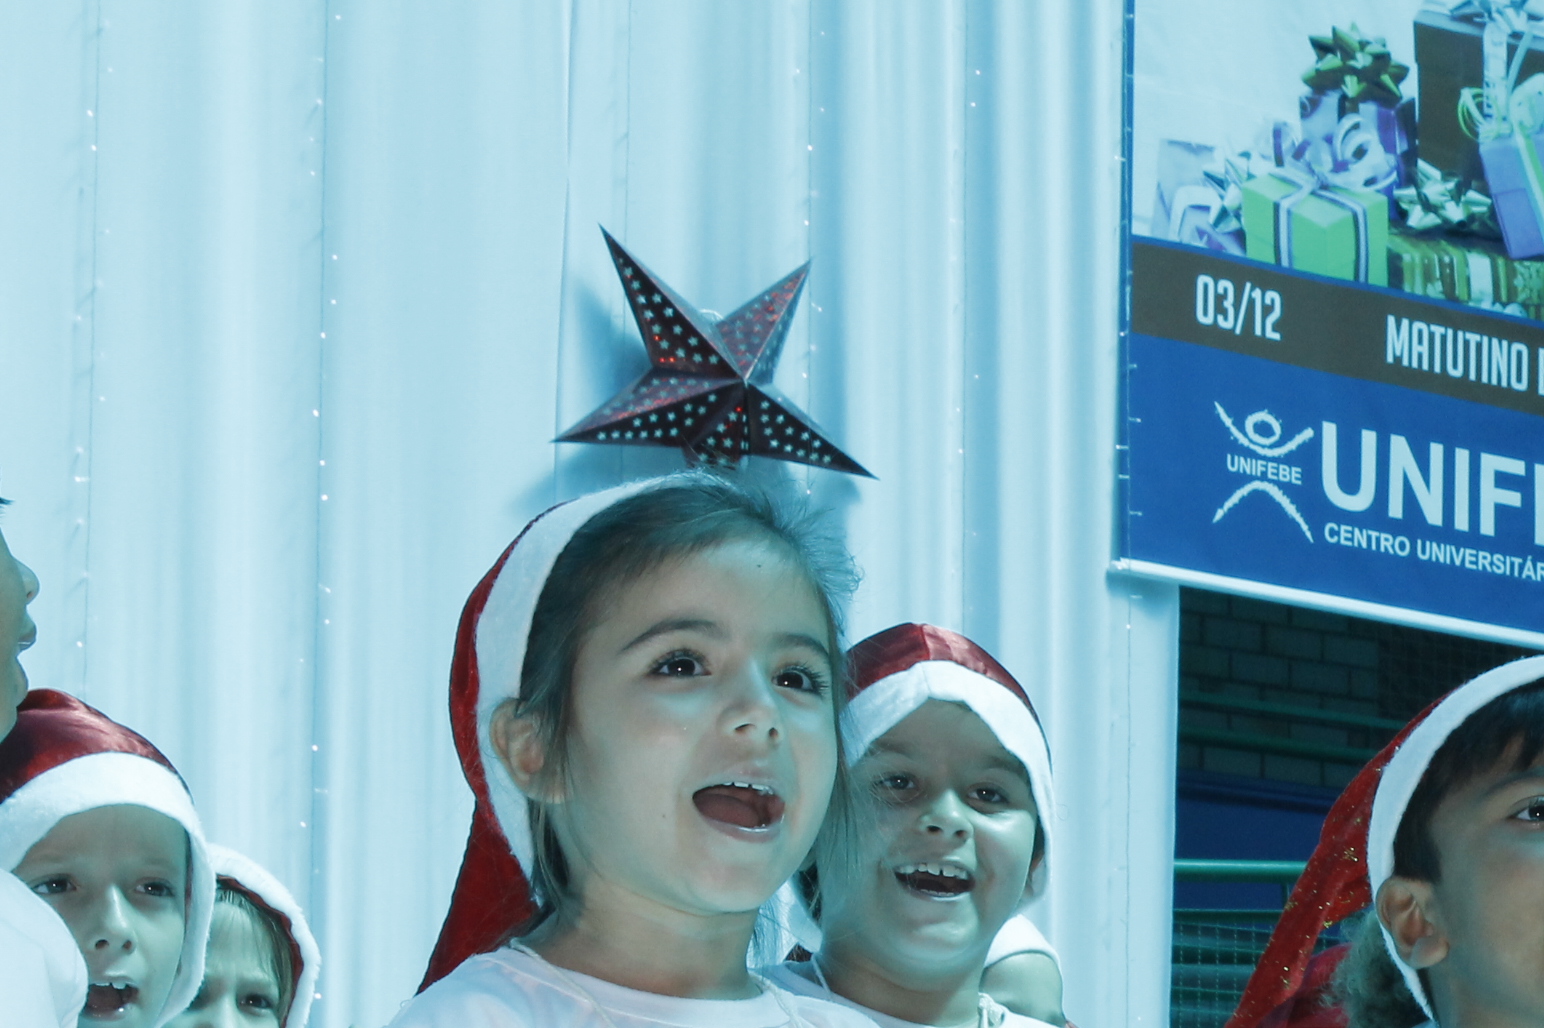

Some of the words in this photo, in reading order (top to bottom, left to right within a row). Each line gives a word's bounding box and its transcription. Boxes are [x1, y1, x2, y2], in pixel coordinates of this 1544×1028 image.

[1194, 273, 1282, 342] 03/12
[1386, 314, 1528, 392] MATUTINO
[1225, 453, 1303, 487] UNIFEBE
[1323, 521, 1411, 558] CENTRO
